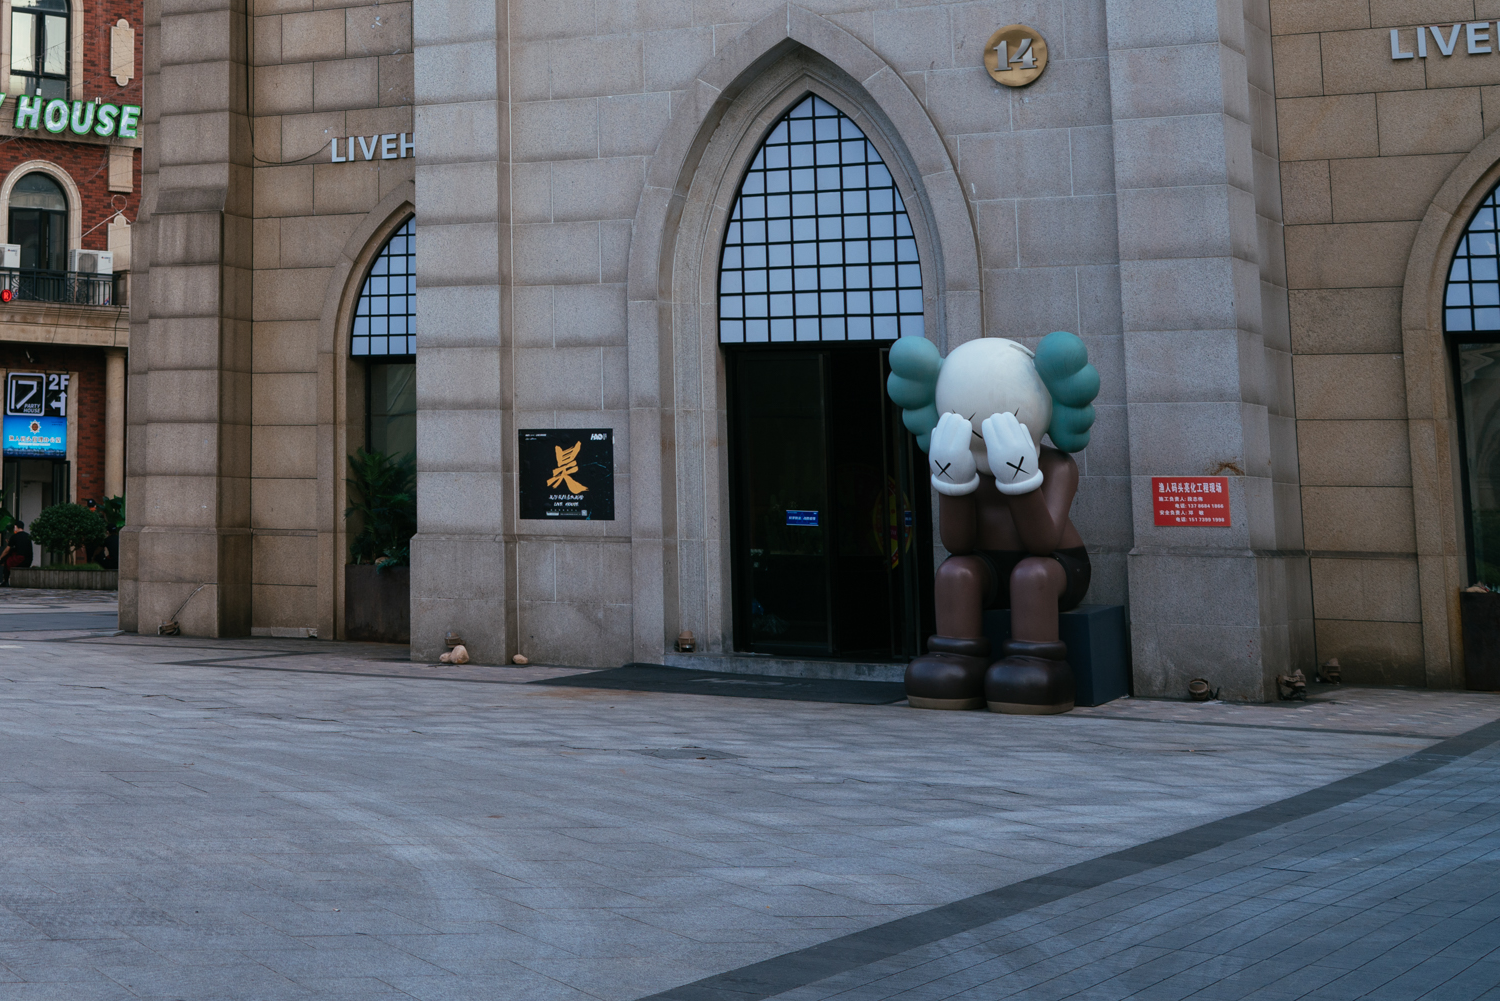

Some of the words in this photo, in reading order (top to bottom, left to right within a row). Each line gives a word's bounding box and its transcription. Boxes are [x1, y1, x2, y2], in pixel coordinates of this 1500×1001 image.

[993, 38, 1038, 72] 14
[1390, 21, 1500, 60] LIVE
[15, 94, 141, 139] HOUSE
[331, 132, 416, 163] LIVEH
[49, 374, 70, 390] 2F
[1158, 482, 1222, 493] 渔人码头亮化工程现场
